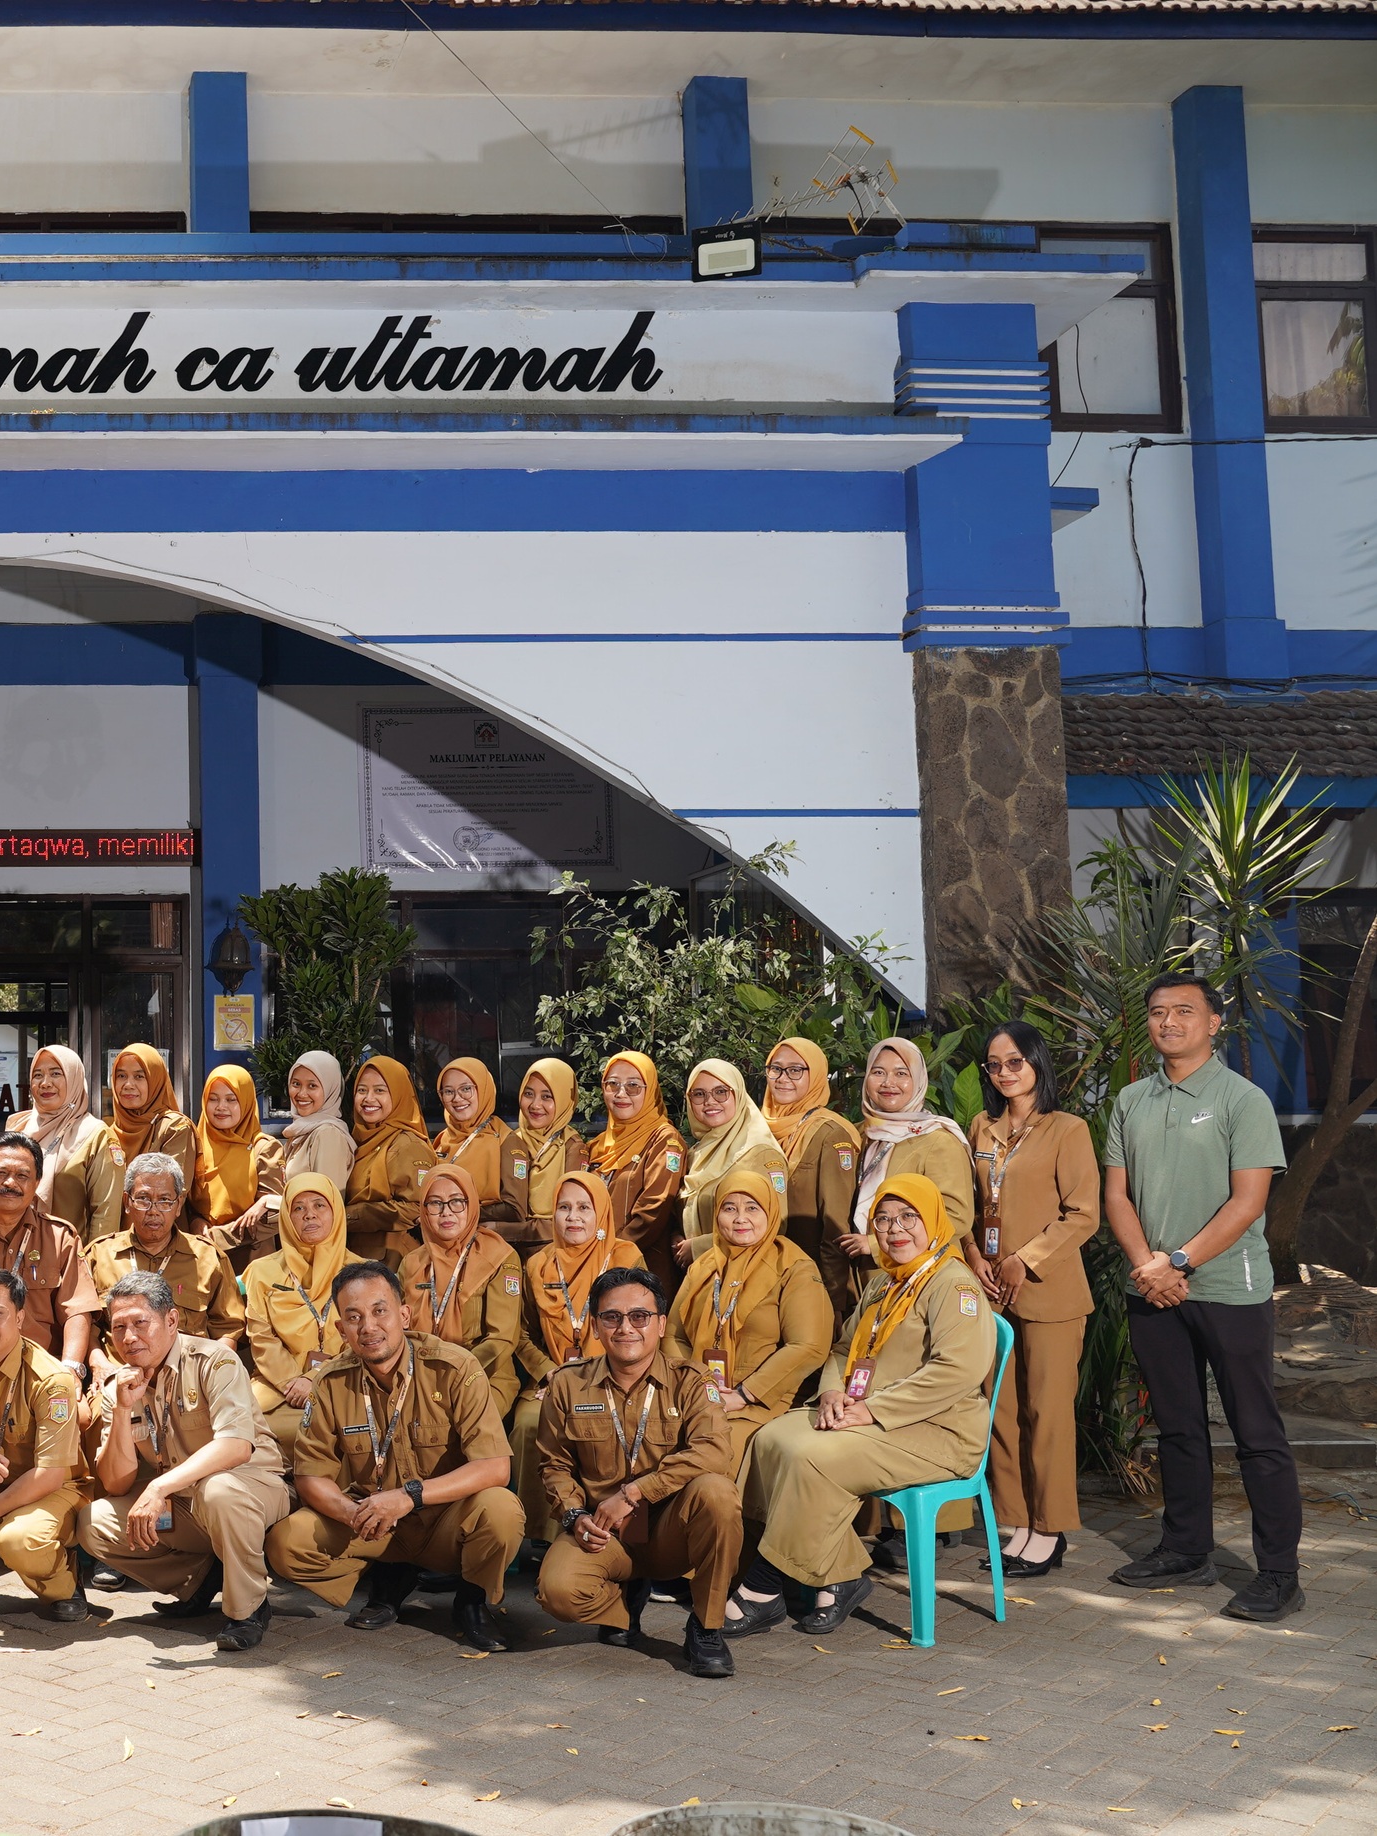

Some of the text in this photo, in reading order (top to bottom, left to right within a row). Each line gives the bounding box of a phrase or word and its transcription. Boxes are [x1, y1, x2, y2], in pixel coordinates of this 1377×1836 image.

[175, 346, 274, 392] ca
[294, 311, 663, 392] uttamah
[429, 753, 546, 763] MAKLUMAT PELAYANAN
[98, 833, 194, 856] memiliki
